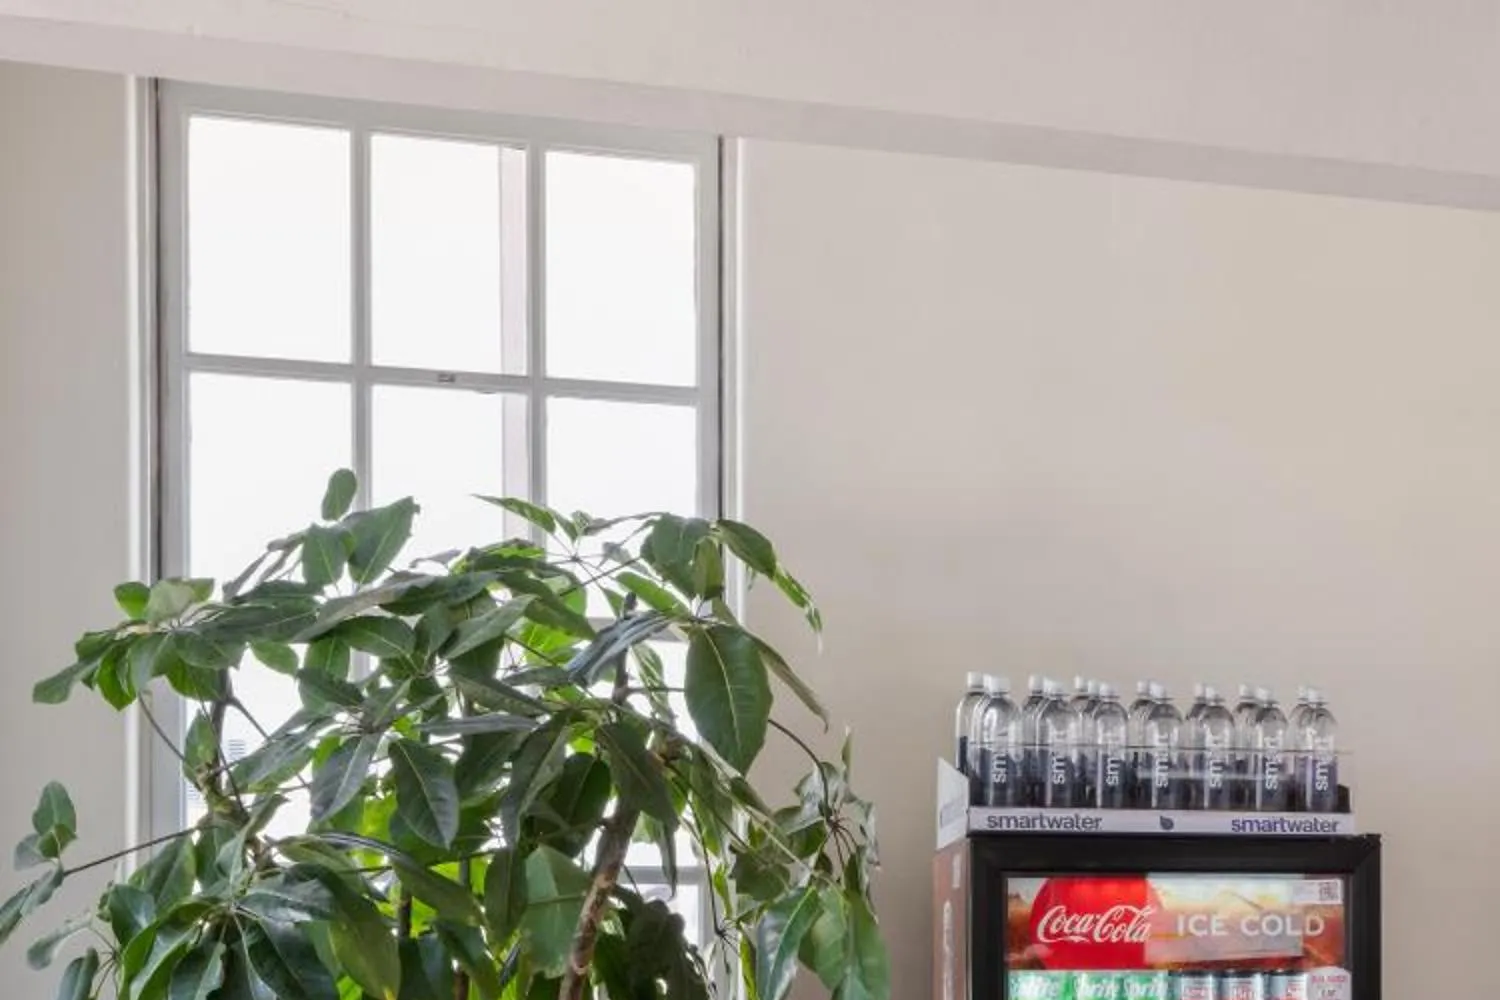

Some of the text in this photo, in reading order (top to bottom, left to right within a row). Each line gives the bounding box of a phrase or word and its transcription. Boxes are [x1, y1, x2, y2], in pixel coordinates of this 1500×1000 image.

[987, 813, 1103, 830] smartwater
[1231, 816, 1340, 833] smartwater
[1036, 904, 1157, 943] Coca-Cola
[1177, 913, 1325, 937] ICE COLD
